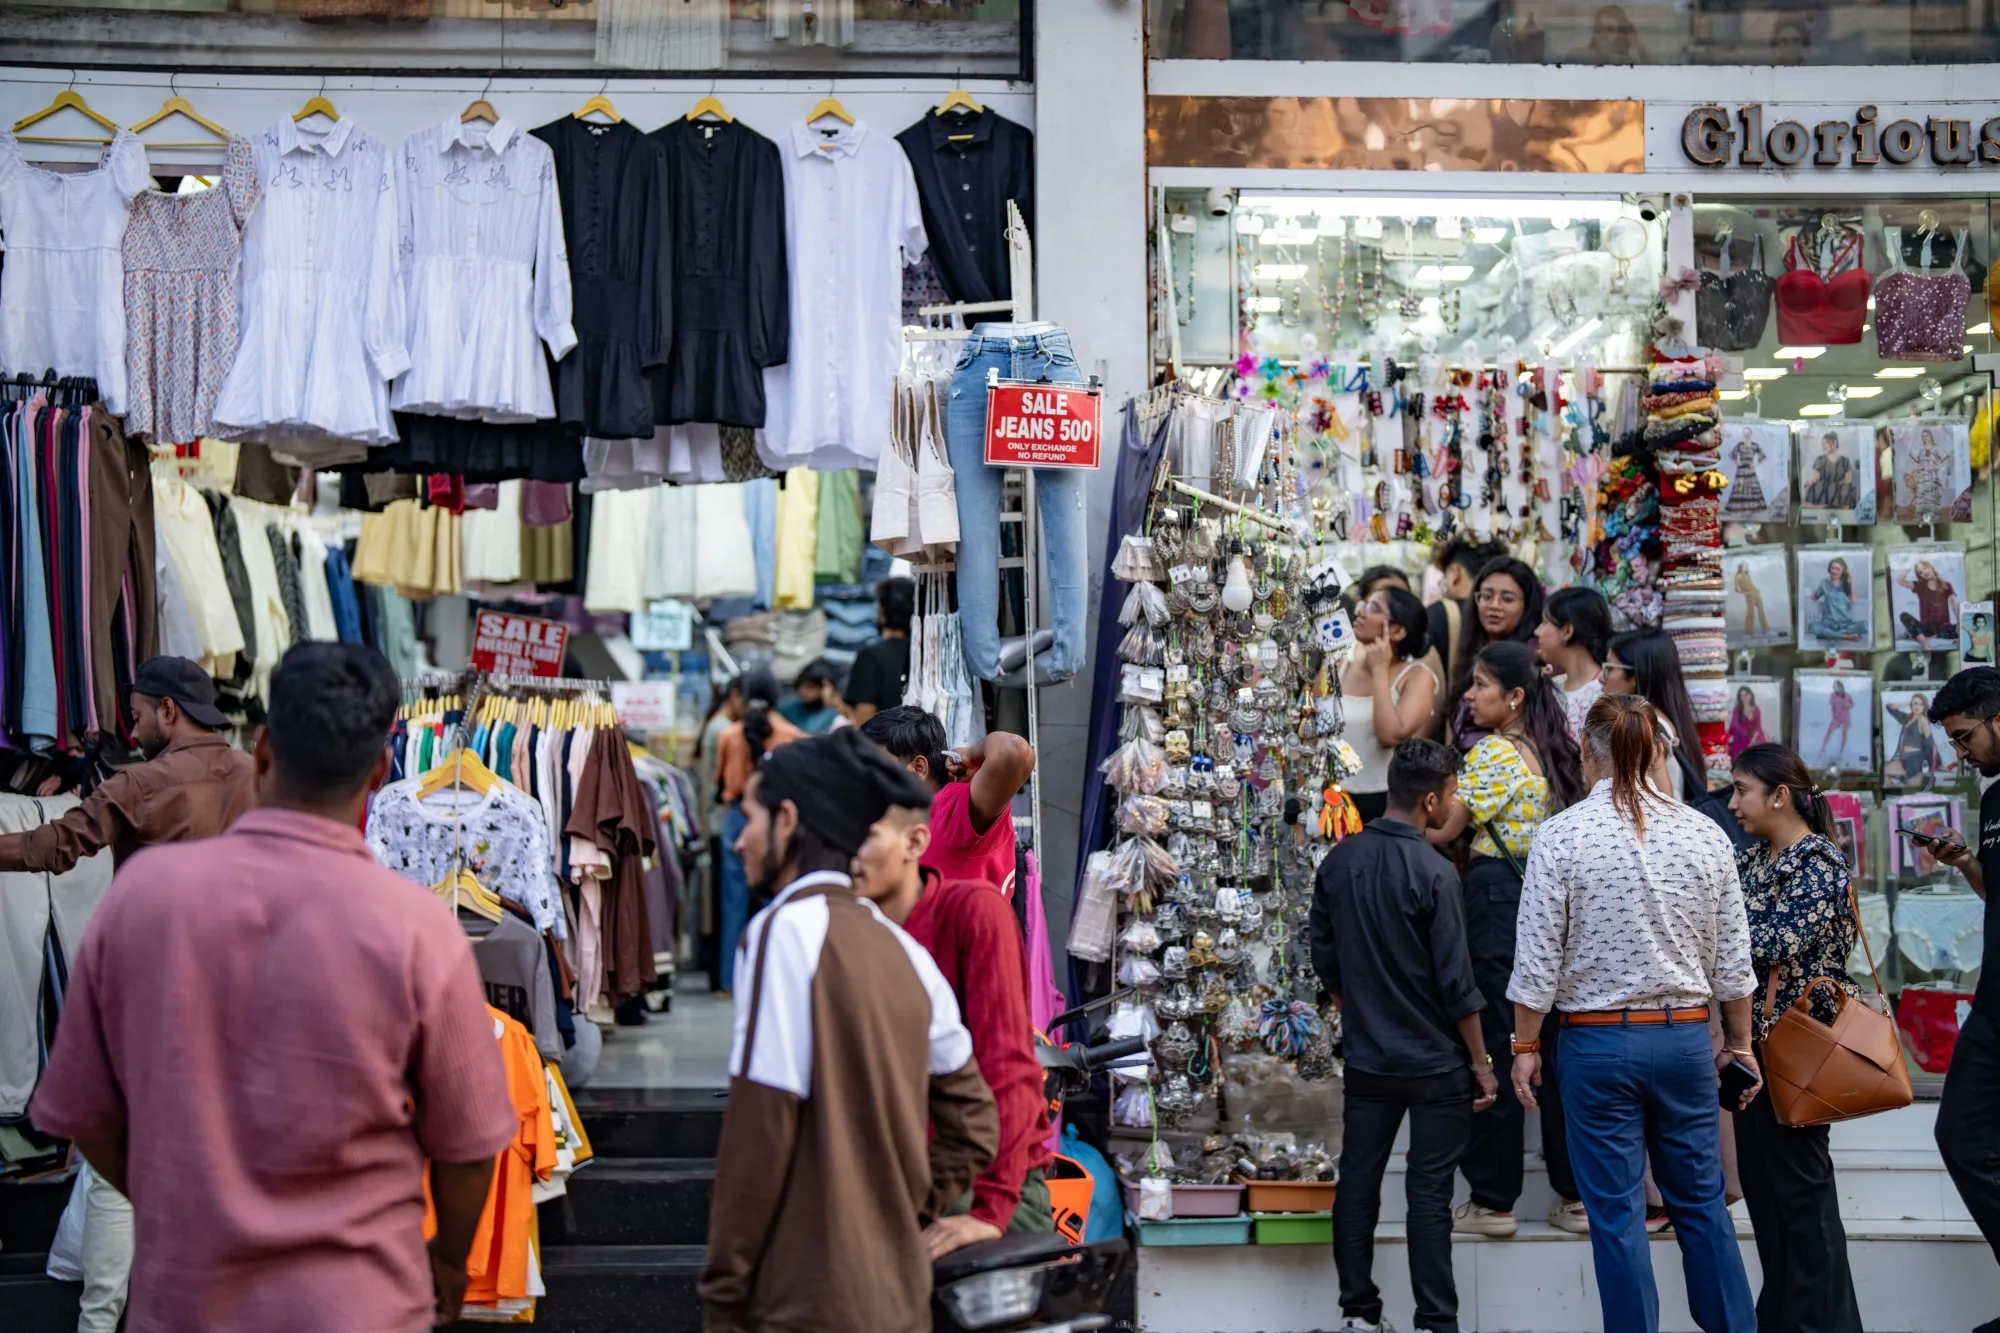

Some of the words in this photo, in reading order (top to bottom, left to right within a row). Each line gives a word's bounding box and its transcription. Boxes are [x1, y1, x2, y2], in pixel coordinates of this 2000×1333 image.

[1681, 103, 2000, 166] Glorious
[1021, 392, 1068, 415] SALE
[995, 416, 1054, 440] JEANS
[1059, 419, 1092, 442] 500
[1007, 442, 1030, 451] ONLY
[1031, 443, 1077, 453] EXCHANGE
[1018, 452, 1030, 460] NO
[1032, 452, 1066, 461] REFUND
[480, 614, 563, 648] SALE
